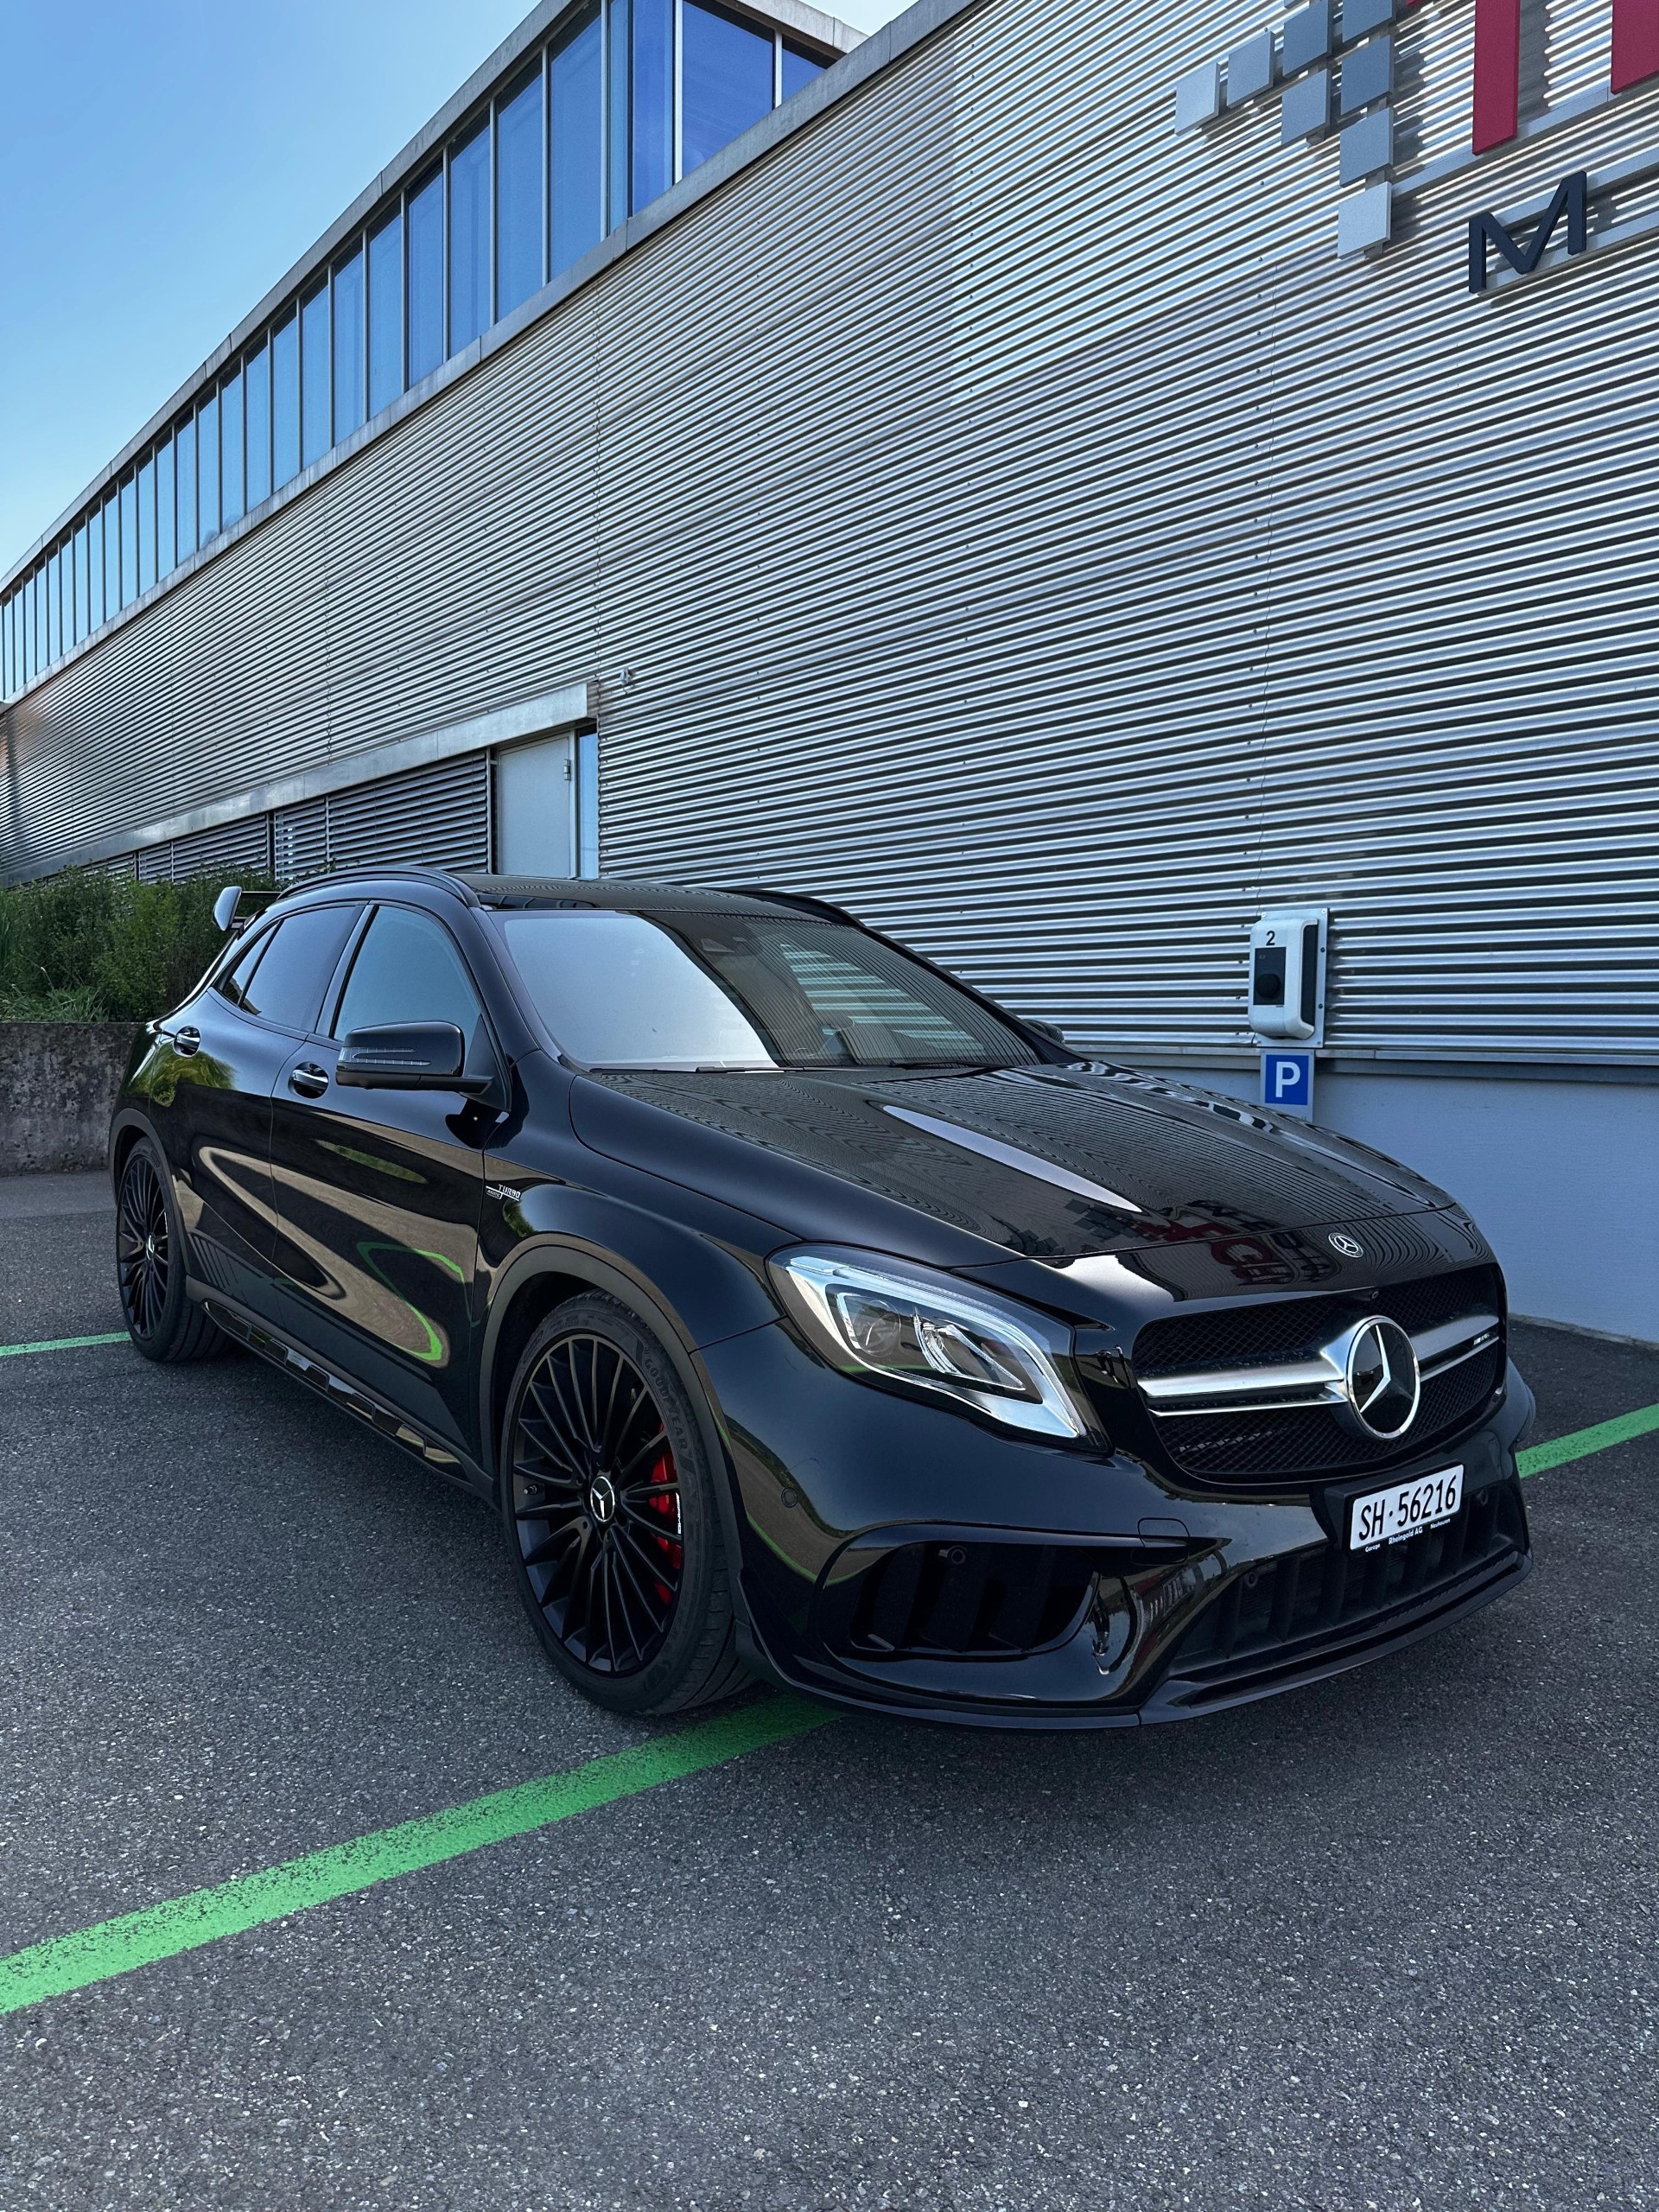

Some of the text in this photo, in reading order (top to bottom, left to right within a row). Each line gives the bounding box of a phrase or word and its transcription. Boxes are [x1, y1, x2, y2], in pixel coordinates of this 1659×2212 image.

[1266, 930, 1275, 946] 2
[1275, 1061, 1300, 1098] P
[498, 1184, 521, 1198] TURBO
[1414, 1526, 1423, 1538] AG
